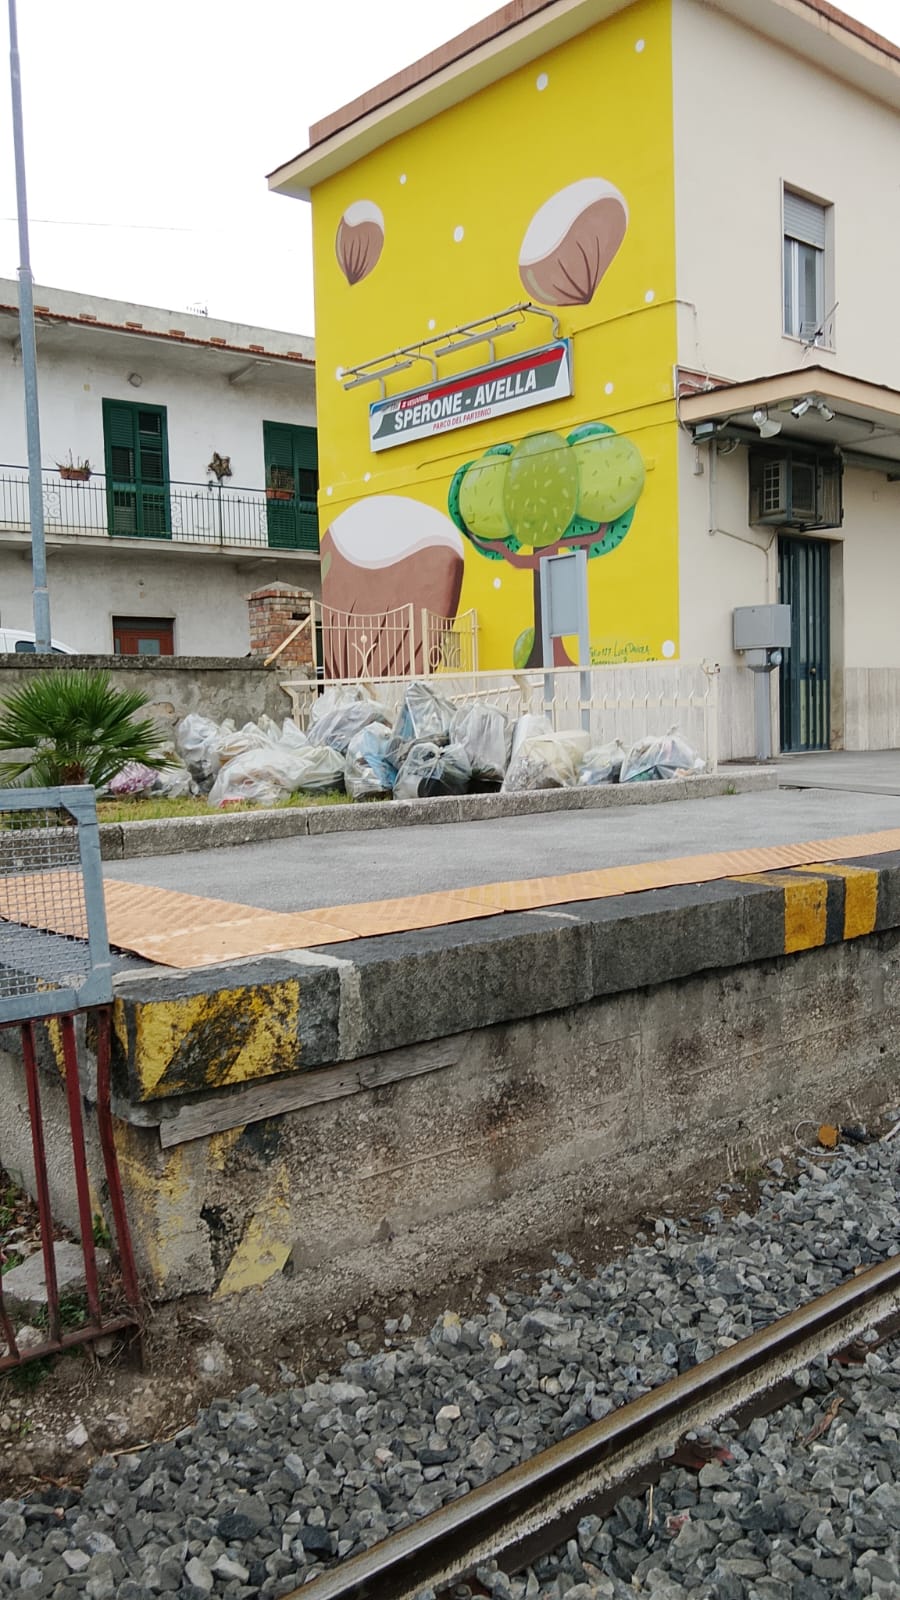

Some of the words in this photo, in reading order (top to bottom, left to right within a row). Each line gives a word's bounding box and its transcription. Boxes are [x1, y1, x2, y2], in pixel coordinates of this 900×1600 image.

[394, 392, 462, 430] SPERONE
[474, 369, 537, 407] AVELLA
[432, 418, 451, 431] PARCO
[451, 415, 461, 426] DEL
[463, 408, 491, 423] PARTENIO
